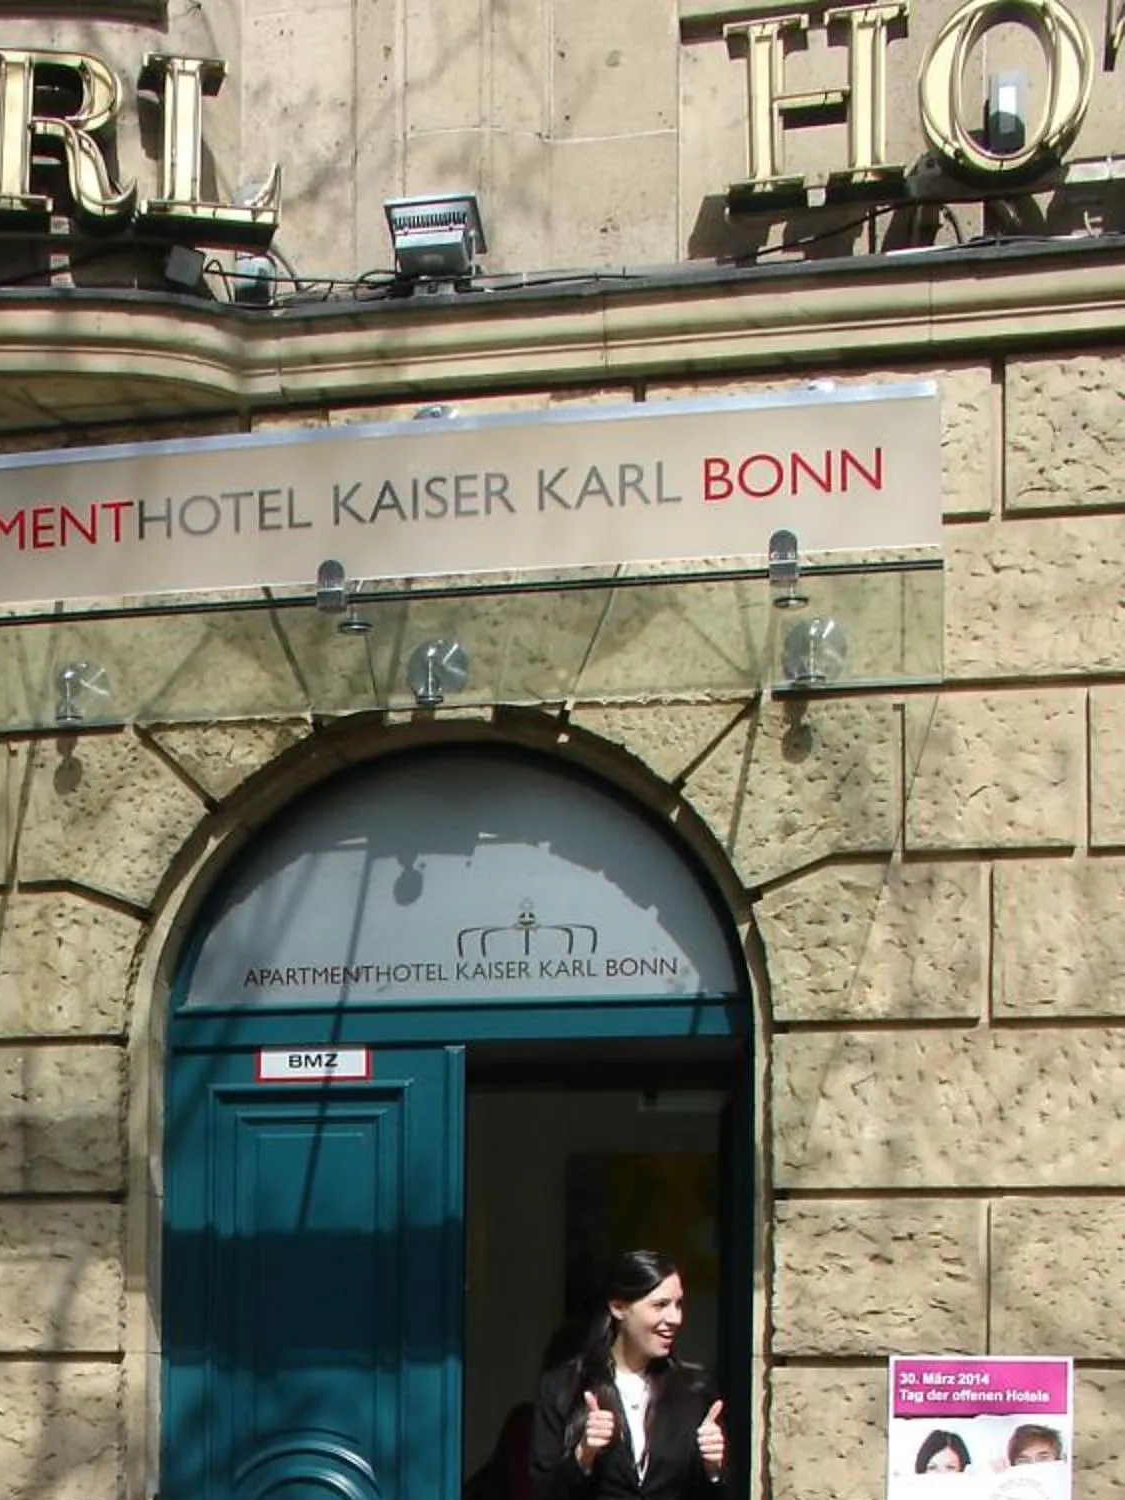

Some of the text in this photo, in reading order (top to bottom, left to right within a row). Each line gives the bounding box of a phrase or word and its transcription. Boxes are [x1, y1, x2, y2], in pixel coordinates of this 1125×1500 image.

[723, 0, 1125, 212] HO
[332, 471, 517, 526] KAISER
[537, 461, 683, 511] KARL
[702, 447, 883, 502] BONN
[243, 956, 679, 987] APARTMENTHOTEL KAISER KARL BONN
[287, 1052, 339, 1069] BMZ
[899, 1372, 991, 1386] 30. März 2014
[900, 1389, 1051, 1404] Tag der offenen Hotels
